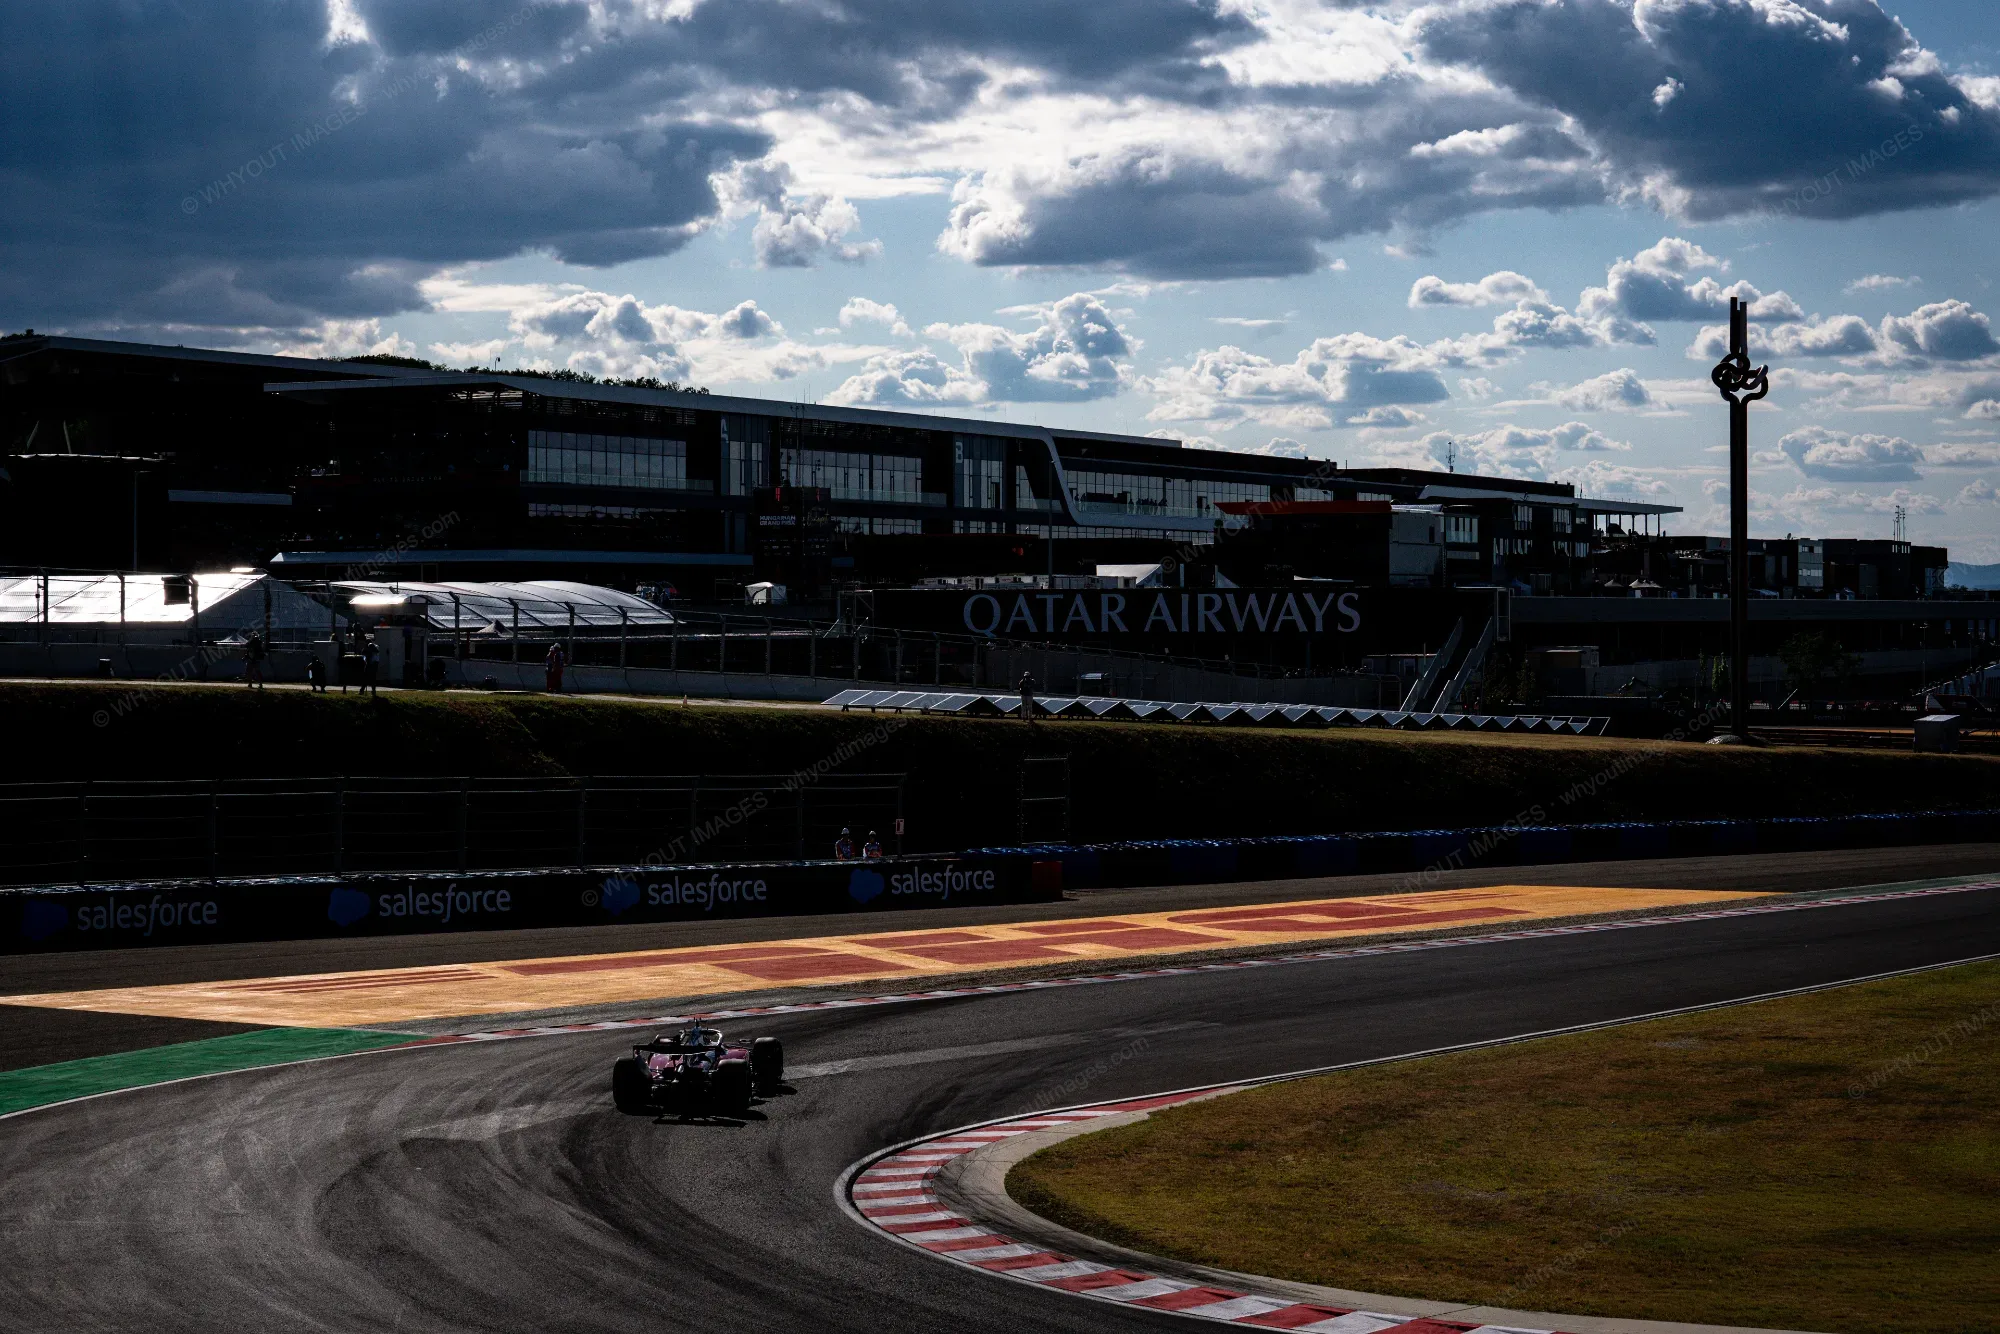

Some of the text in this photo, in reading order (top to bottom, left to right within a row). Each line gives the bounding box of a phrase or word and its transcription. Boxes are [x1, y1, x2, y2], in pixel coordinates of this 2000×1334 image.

[963, 592, 1361, 640] QATAR AIRWAYS
[647, 875, 767, 911] salesforce
[887, 864, 995, 900] salesforce
[77, 895, 219, 934] salesforce
[378, 884, 511, 923] salesforce
